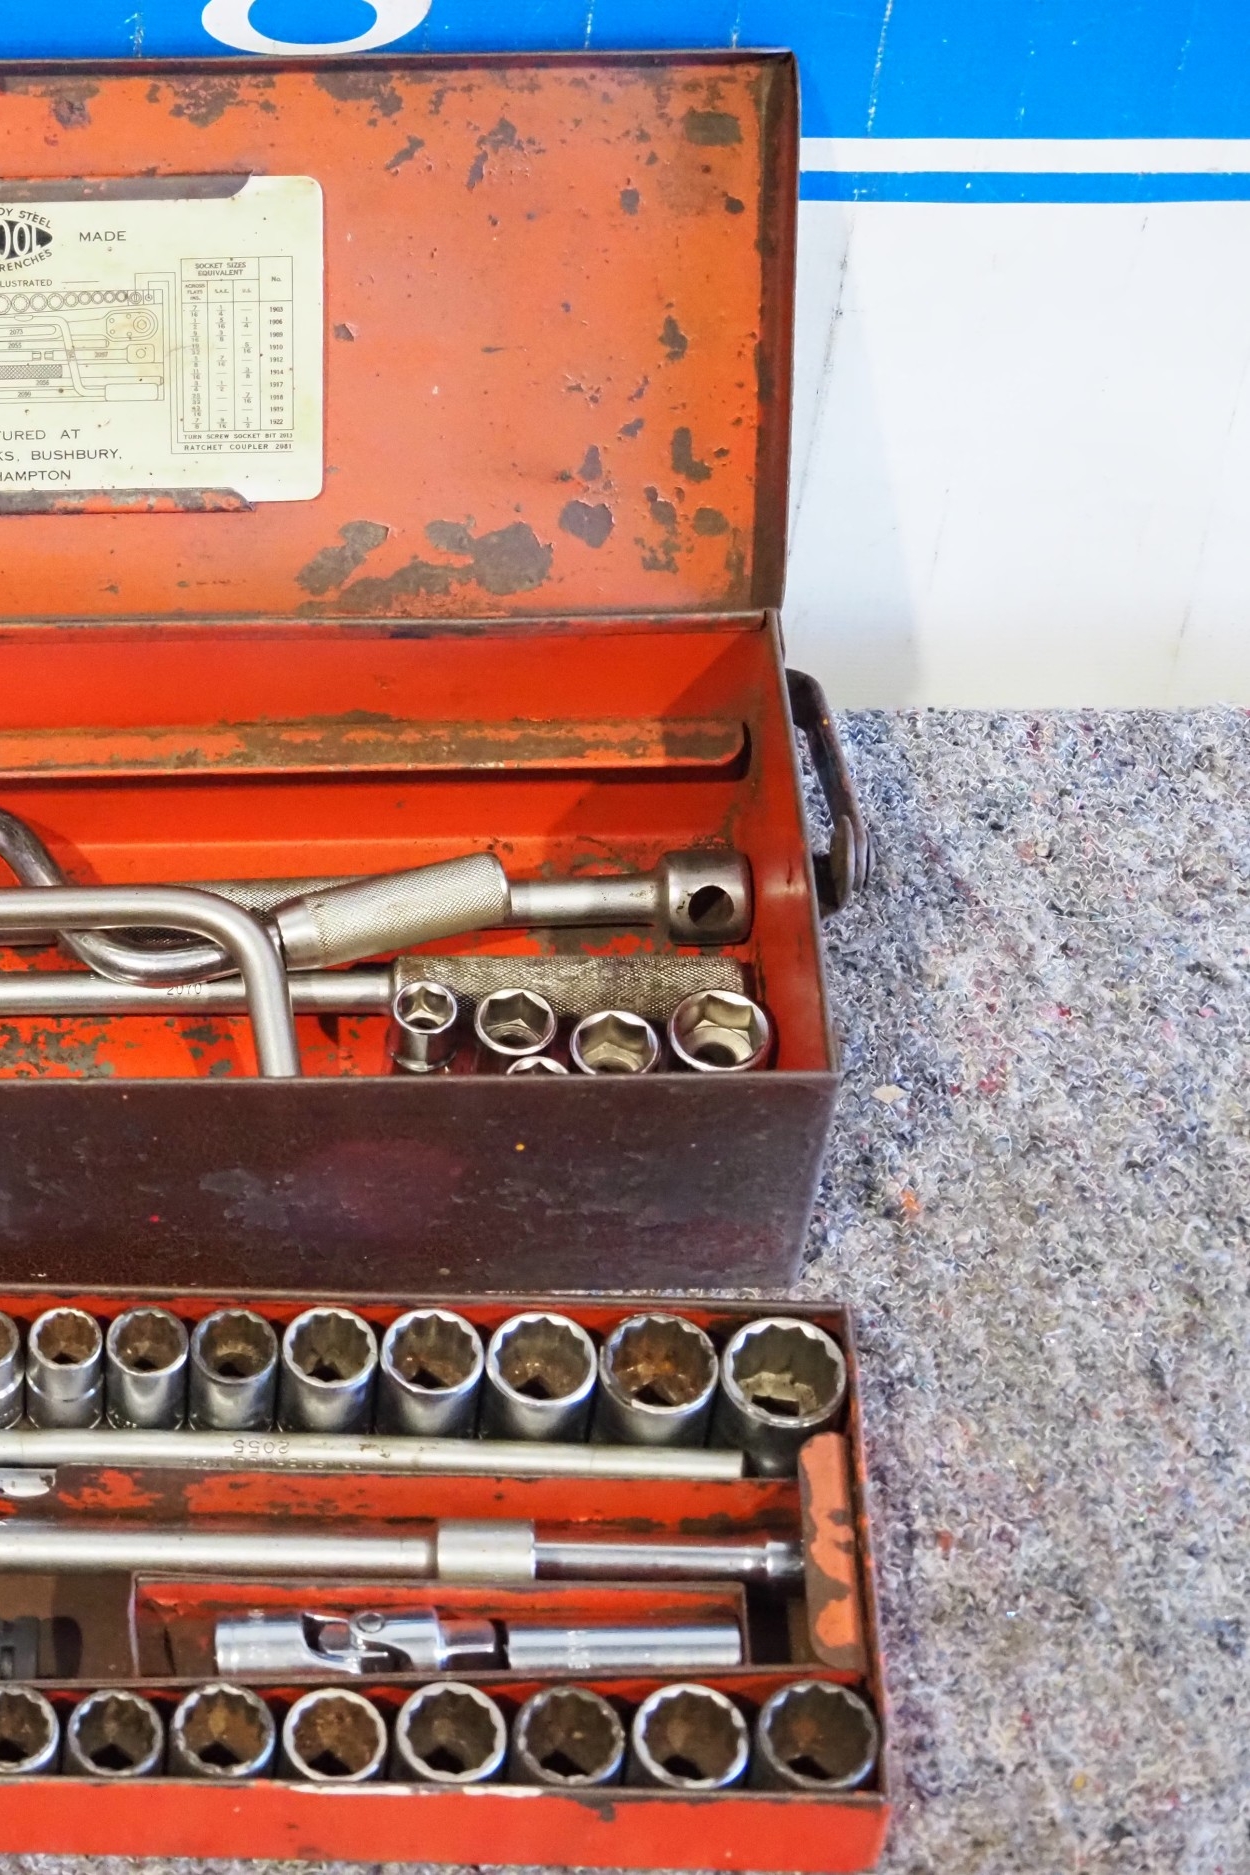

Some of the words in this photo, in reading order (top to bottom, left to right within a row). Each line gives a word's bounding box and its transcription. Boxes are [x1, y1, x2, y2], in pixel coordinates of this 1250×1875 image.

[18, 210, 52, 229] STEEL
[79, 230, 127, 242] MADE
[195, 262, 223, 270] SOCKET
[226, 261, 247, 269] SIZES
[197, 268, 243, 277] EQUIVALENT
[60, 429, 81, 440] AT
[234, 432, 261, 440] SOCKET
[229, 443, 269, 451] COUPLER
[233, 1439, 290, 1454] 2055
